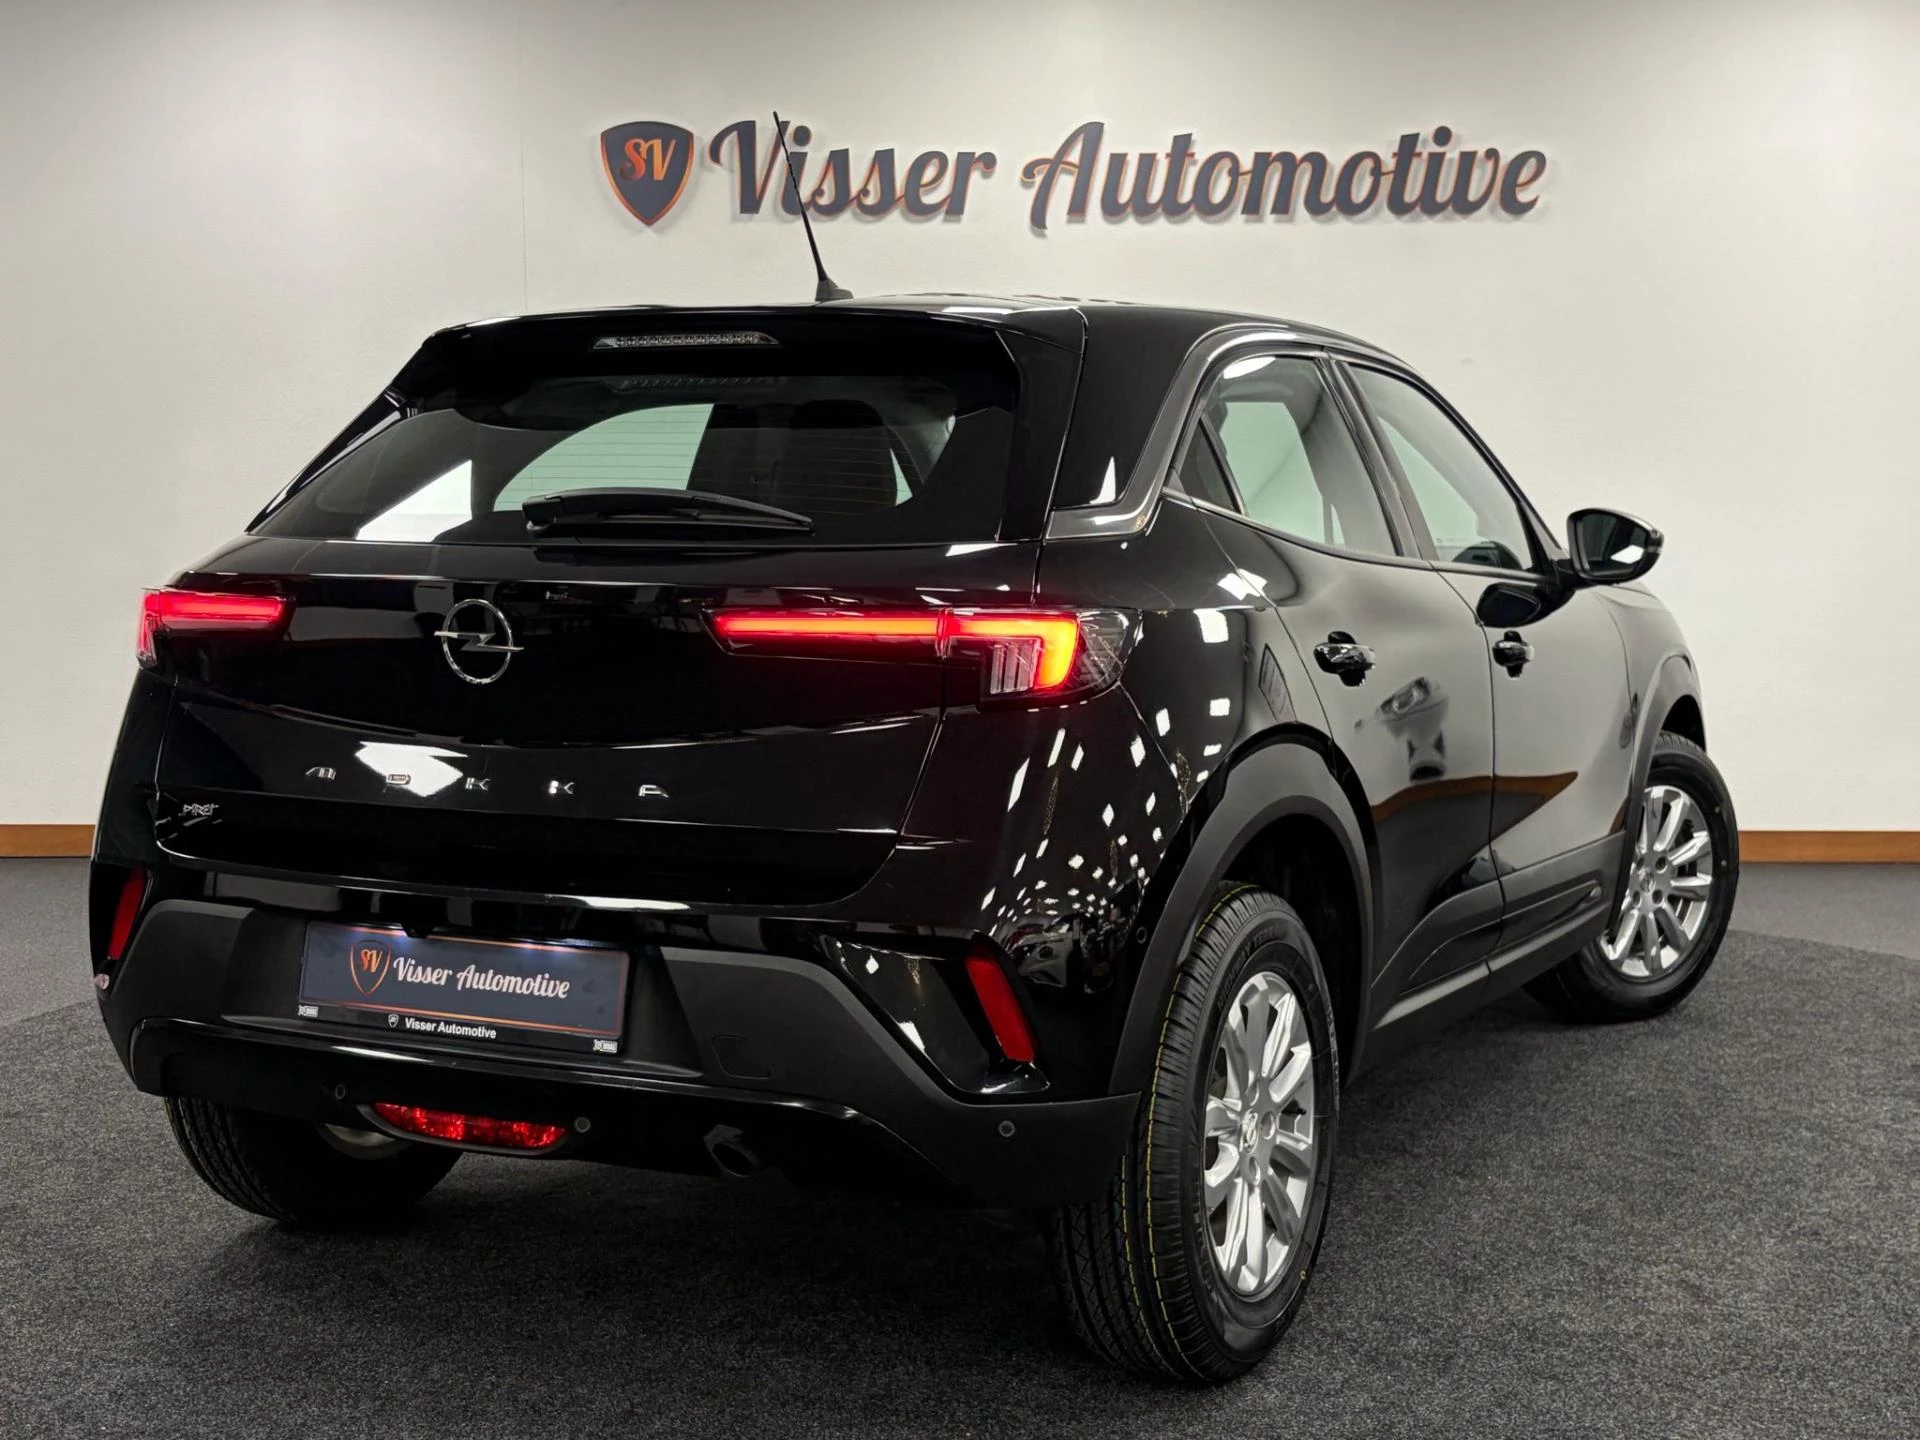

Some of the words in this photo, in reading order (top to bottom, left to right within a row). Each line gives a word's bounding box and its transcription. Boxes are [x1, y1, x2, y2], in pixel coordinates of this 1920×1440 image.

[619, 137, 677, 182] SV
[708, 119, 998, 217] Visser
[1020, 121, 1548, 230] Automotive
[392, 956, 454, 986] Visser
[456, 963, 571, 999] Automotive
[405, 1017, 438, 1032] Visser
[437, 1022, 498, 1040] Automotive
